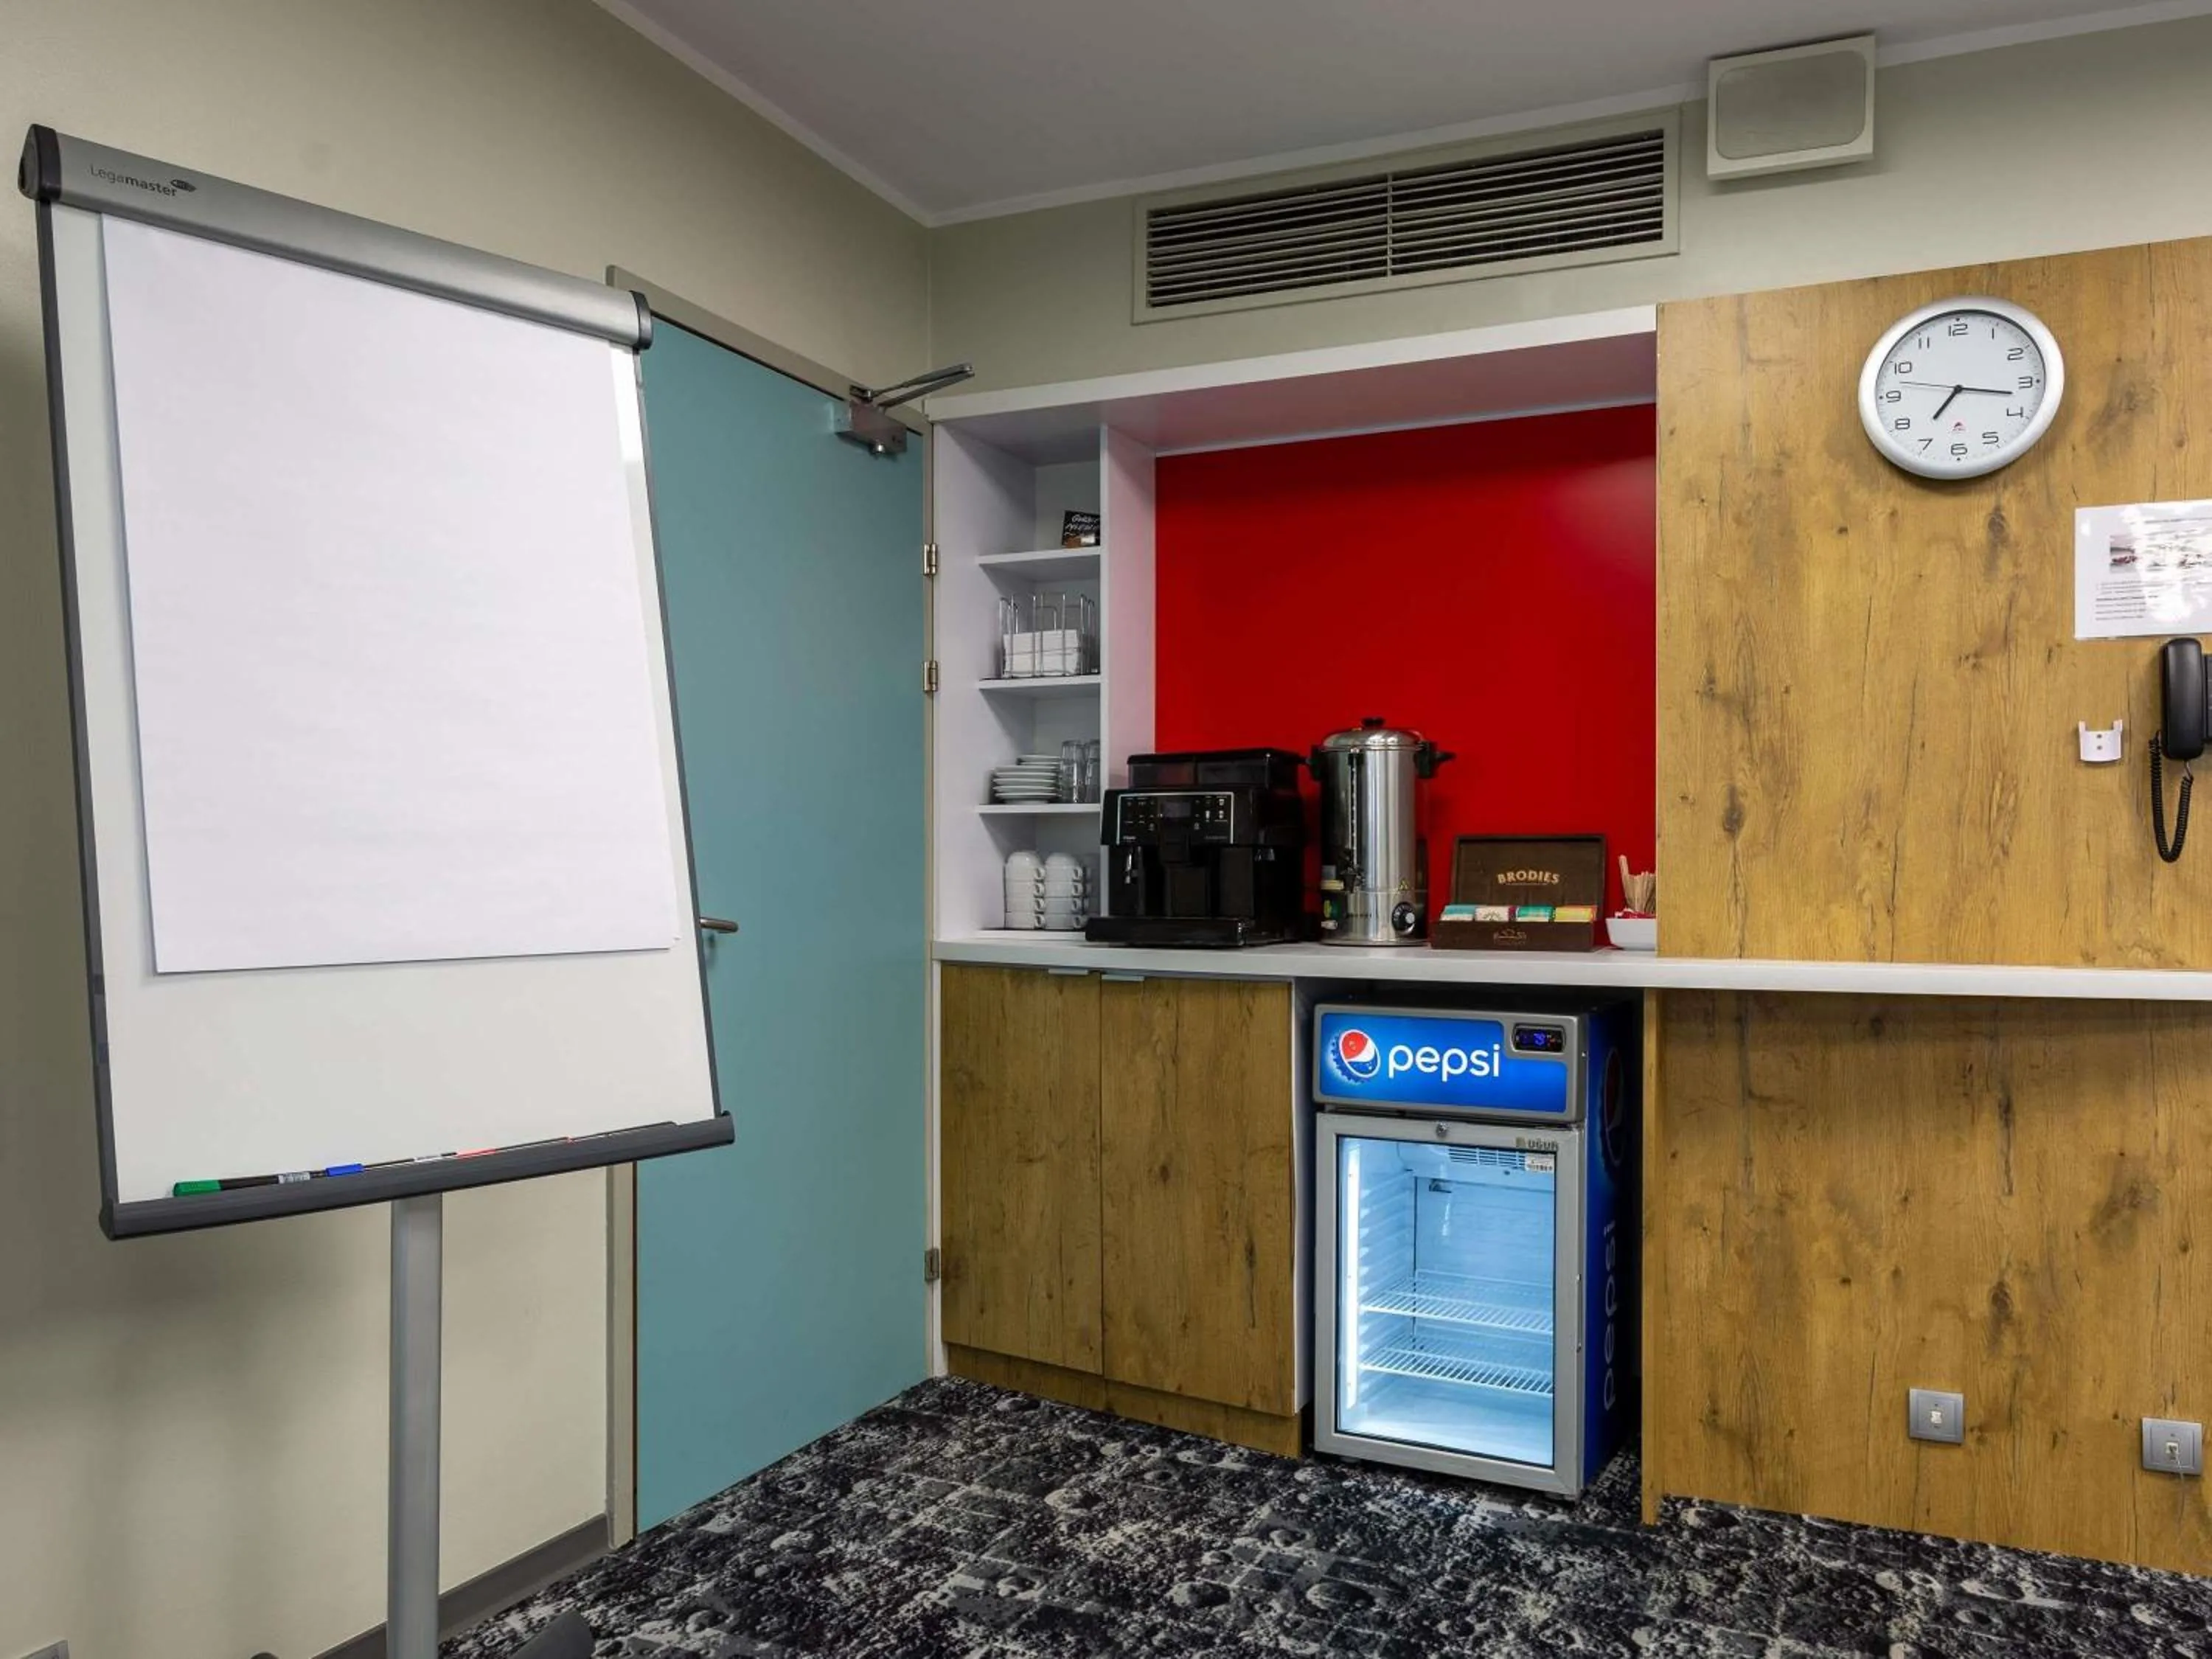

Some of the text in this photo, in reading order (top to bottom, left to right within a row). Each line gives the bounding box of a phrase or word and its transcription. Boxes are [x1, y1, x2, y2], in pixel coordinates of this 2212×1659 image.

[90, 164, 178, 197] Legamaster
[1947, 323, 1969, 337] 12
[1918, 336, 1930, 349] 11
[2006, 347, 2024, 361] 2
[1894, 361, 1913, 375] 10
[2018, 376, 2033, 389] 3
[1885, 391, 1902, 403] 9
[2006, 406, 2024, 418] 4
[1894, 417, 1910, 430] 8
[1917, 438, 1933, 451] 7
[1982, 431, 2000, 445] 5
[1950, 442, 1968, 456] 6
[1498, 870, 1560, 885] BRODIES
[1388, 1043, 1501, 1083] pepsi
